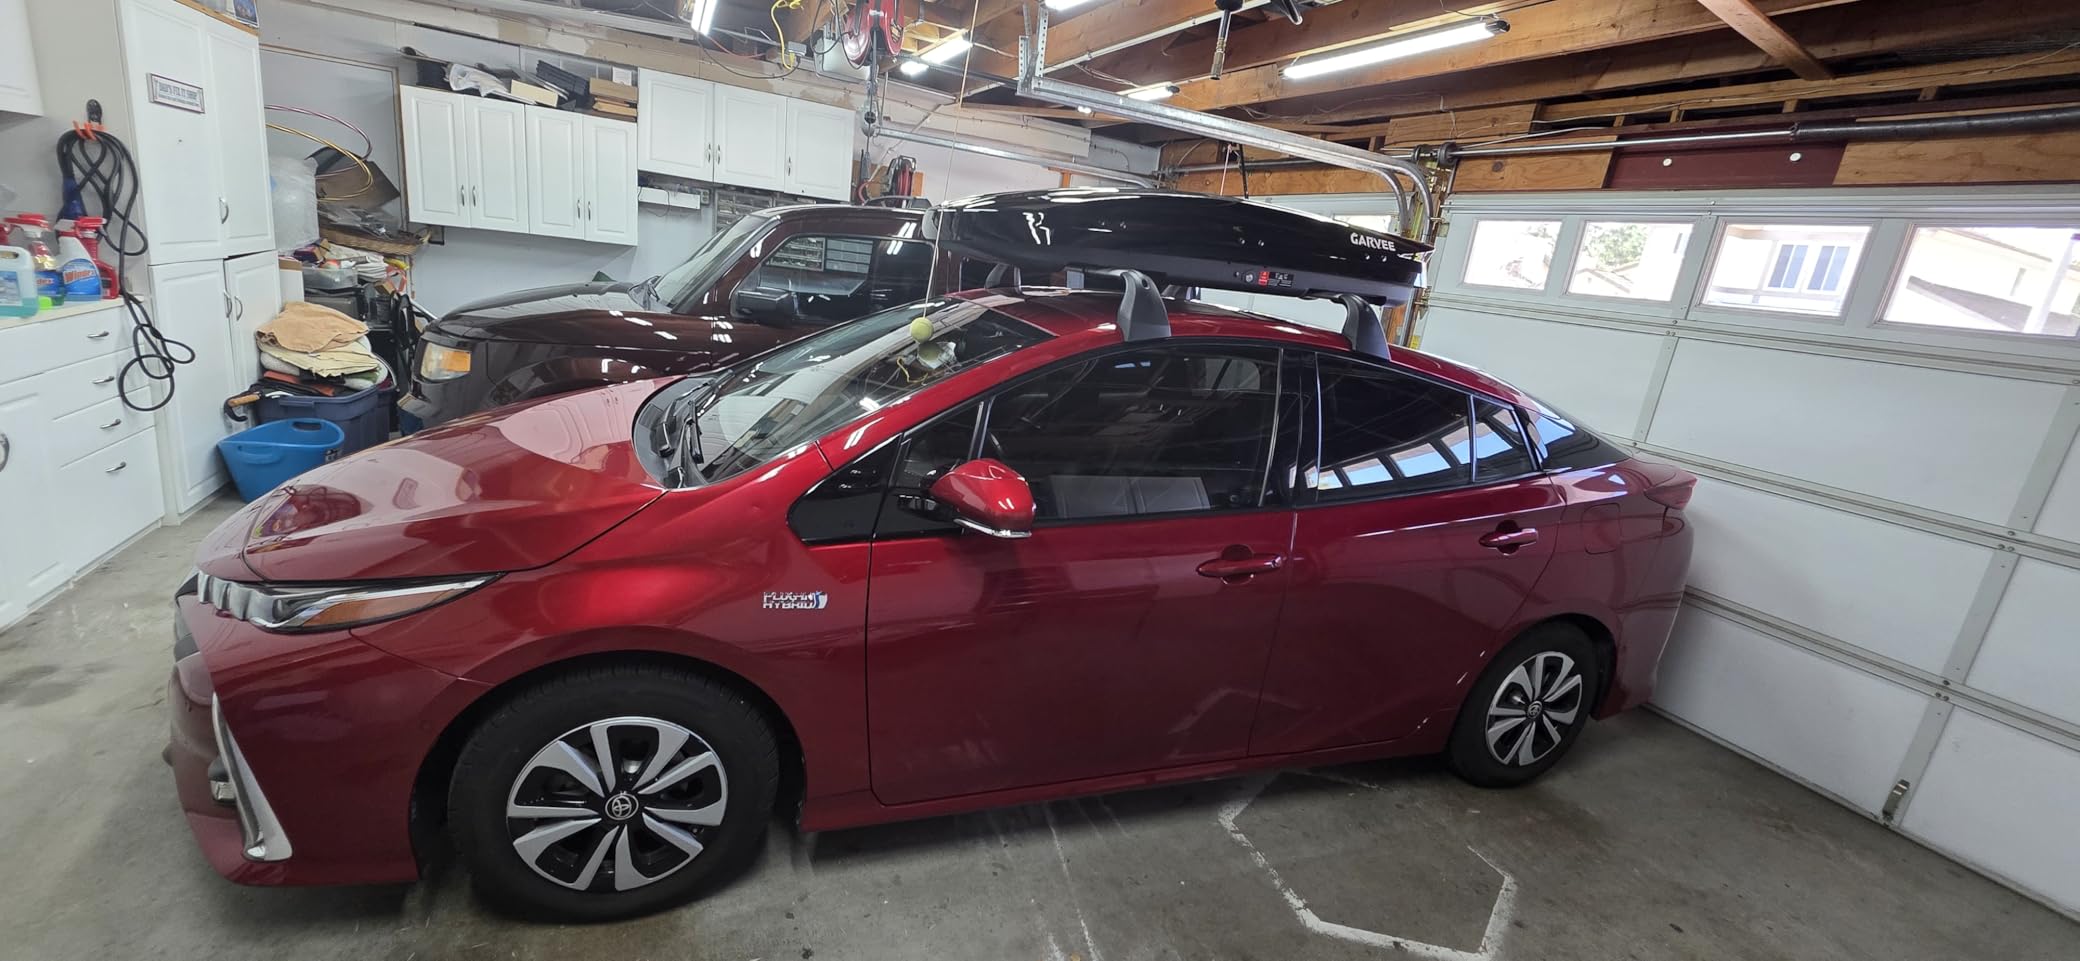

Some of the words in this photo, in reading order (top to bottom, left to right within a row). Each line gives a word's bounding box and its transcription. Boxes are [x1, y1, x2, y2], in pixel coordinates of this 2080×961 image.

[1350, 232, 1396, 251] GARVEE
[64, 270, 95, 283] Windex
[36, 278, 54, 286] dex
[763, 601, 815, 609] HYBRID
